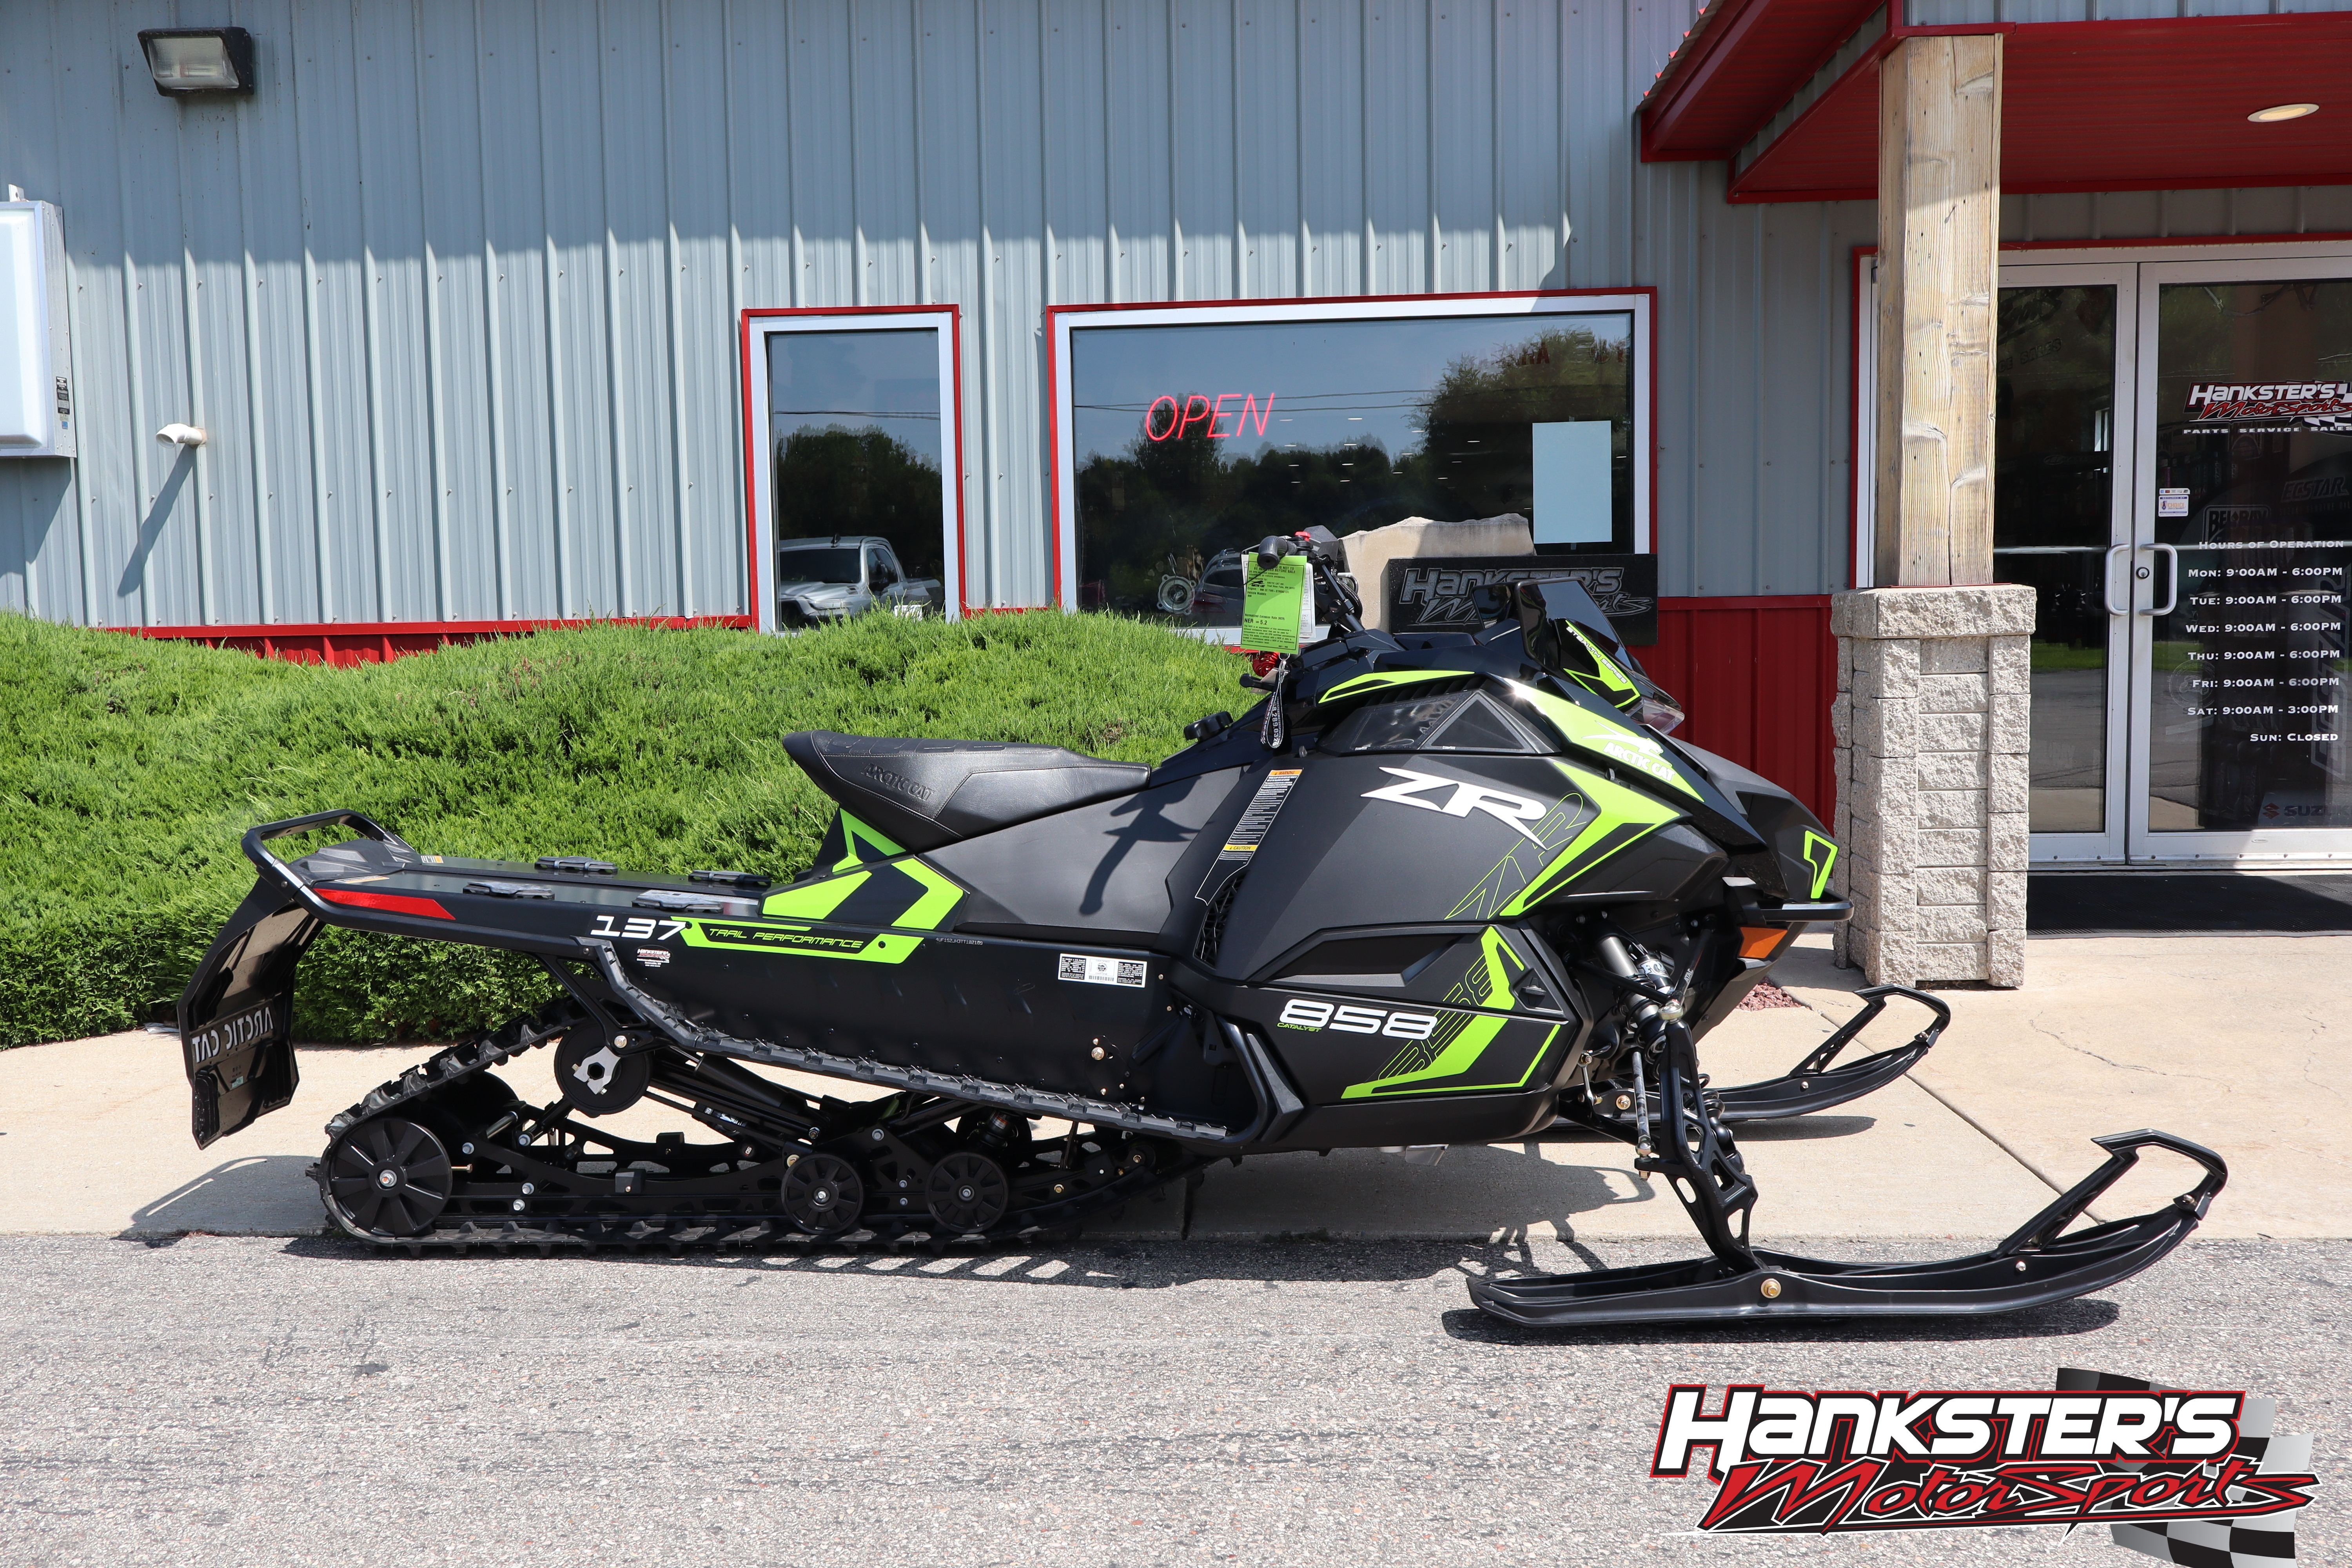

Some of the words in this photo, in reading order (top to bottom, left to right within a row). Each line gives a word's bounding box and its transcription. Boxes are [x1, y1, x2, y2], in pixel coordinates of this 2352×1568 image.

[2189, 384, 2336, 406] HANKSTER'S
[1145, 392, 1276, 442] OPEN
[2198, 541, 2243, 550] HOURS
[2269, 540, 2344, 548] OPERATION
[2188, 569, 2221, 577] MON:
[2292, 567, 2342, 576] 6:00PM
[2190, 597, 2220, 605] TUE:
[2225, 596, 2277, 604] 9:00AM
[2291, 595, 2341, 604] 6:00PM
[2185, 624, 2220, 633] WED:
[2224, 623, 2276, 632] 9:00AM
[2290, 622, 2341, 631] 6:00PM
[1566, 626, 1601, 659] STEALTH
[1601, 658, 1627, 684] SERIES
[2188, 652, 2219, 660] THU:
[2224, 651, 2275, 660] 9:00AM
[2289, 650, 2340, 659] 6:00PM
[2192, 679, 2218, 688] FRI:
[2223, 679, 2274, 687] 9:00AM
[2288, 677, 2339, 686] 6:00PM
[2187, 707, 2218, 715] SAT:
[2223, 706, 2273, 715] 9:00AM
[2288, 705, 2339, 714] 3:00PM
[2250, 733, 2282, 742] SUN:
[2287, 733, 2339, 742] CLOSED
[1603, 742, 1651, 771] ARCTIC
[1651, 762, 1675, 782] CAT
[861, 763, 909, 791] ARCTIC
[907, 780, 935, 801] CAT
[1360, 766, 1548, 850] ZR
[589, 915, 690, 940] 137
[708, 927, 748, 939] TRAIL
[752, 931, 865, 949] PERFORMANCE
[1276, 1022, 1323, 1033] CATALYST
[1279, 999, 1438, 1040] 858
